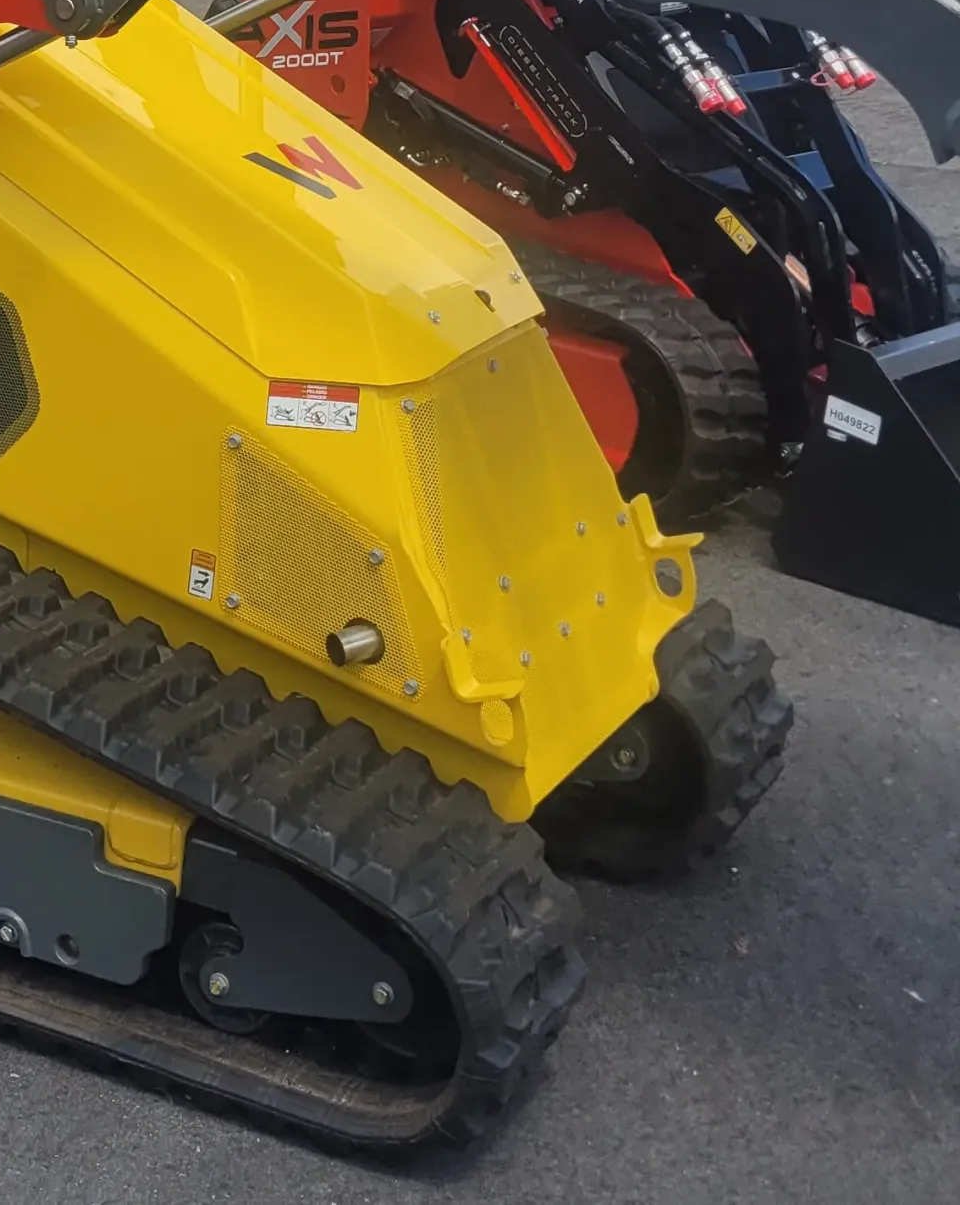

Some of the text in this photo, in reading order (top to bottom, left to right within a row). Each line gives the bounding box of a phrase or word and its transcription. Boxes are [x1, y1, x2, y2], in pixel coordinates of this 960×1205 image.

[272, 51, 344, 69] 200DT
[507, 36, 578, 126] DIESEL TRACK
[829, 407, 876, 436] H049822
